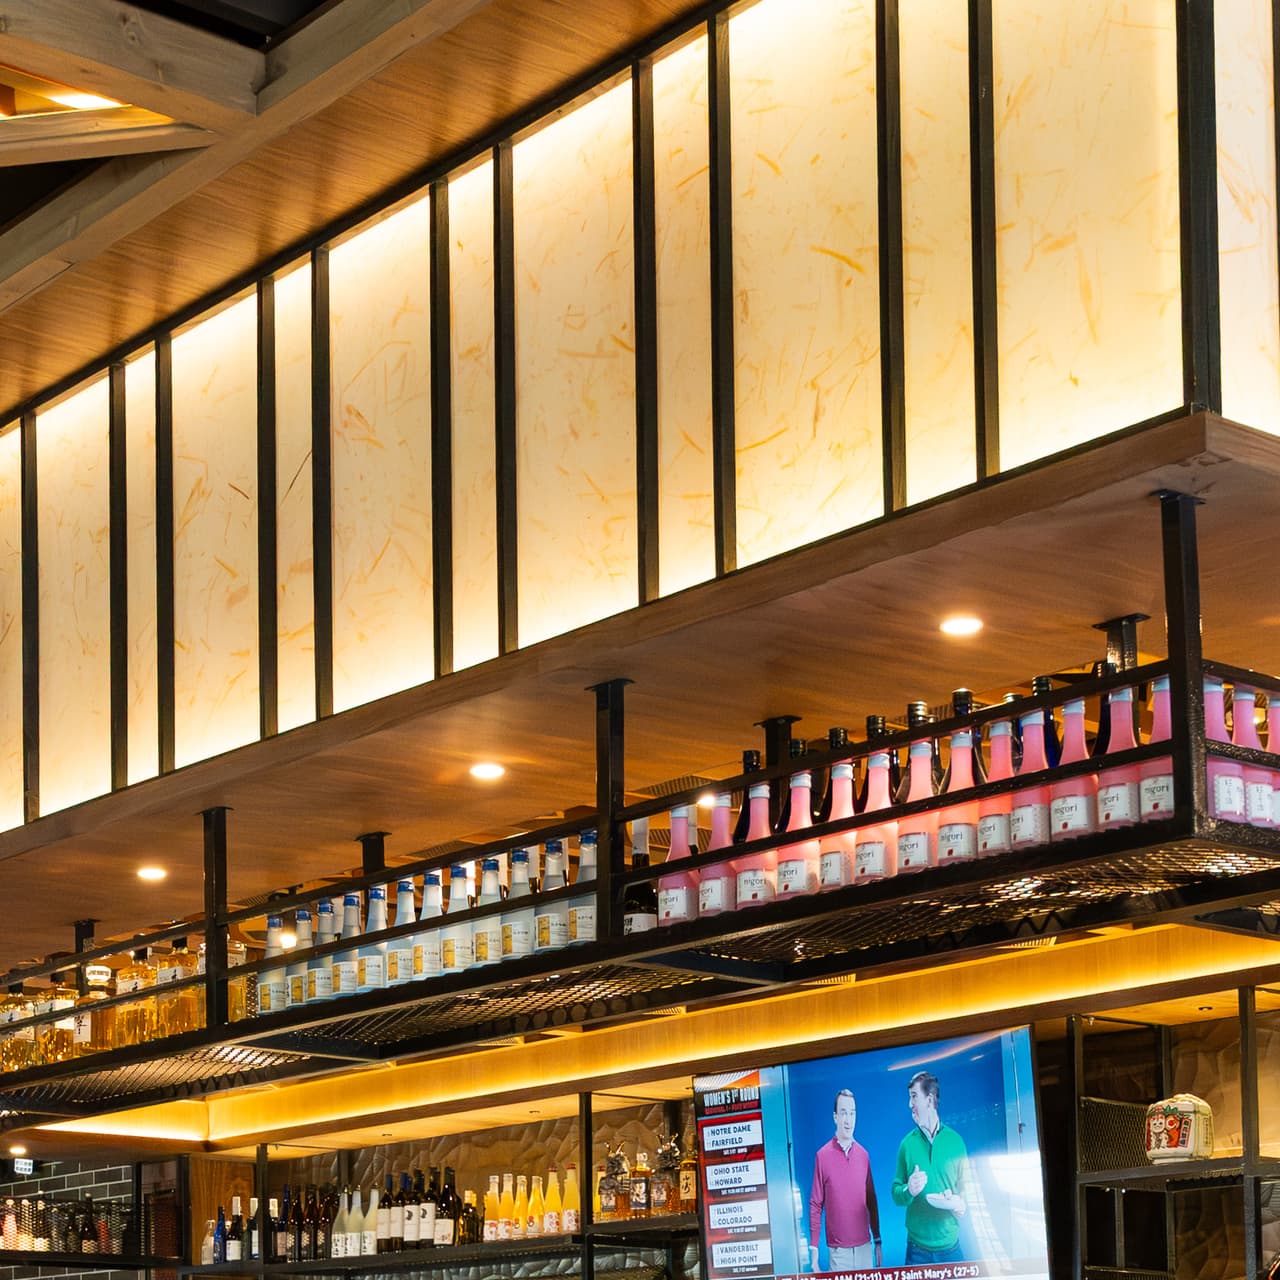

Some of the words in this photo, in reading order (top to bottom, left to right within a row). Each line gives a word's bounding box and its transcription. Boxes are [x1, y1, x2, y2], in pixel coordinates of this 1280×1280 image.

[711, 1126, 731, 1136] NOTRE
[733, 1124, 751, 1133] DAME
[712, 1137, 743, 1147] FAIRFIELD
[714, 1166, 730, 1175] OHIO
[732, 1165, 750, 1174] STATE
[715, 1177, 742, 1186] HOWARD
[718, 1216, 752, 1226] COLORADO
[720, 1244, 759, 1254] VANDERBILT
[721, 1256, 737, 1265] HIGH
[738, 1255, 757, 1264] POINT
[884, 1273, 893, 1280] vs
[894, 1271, 900, 1280] 7
[901, 1269, 923, 1280] Saint
[924, 1268, 952, 1280] Mary's
[954, 1265, 979, 1277] (27-5)
